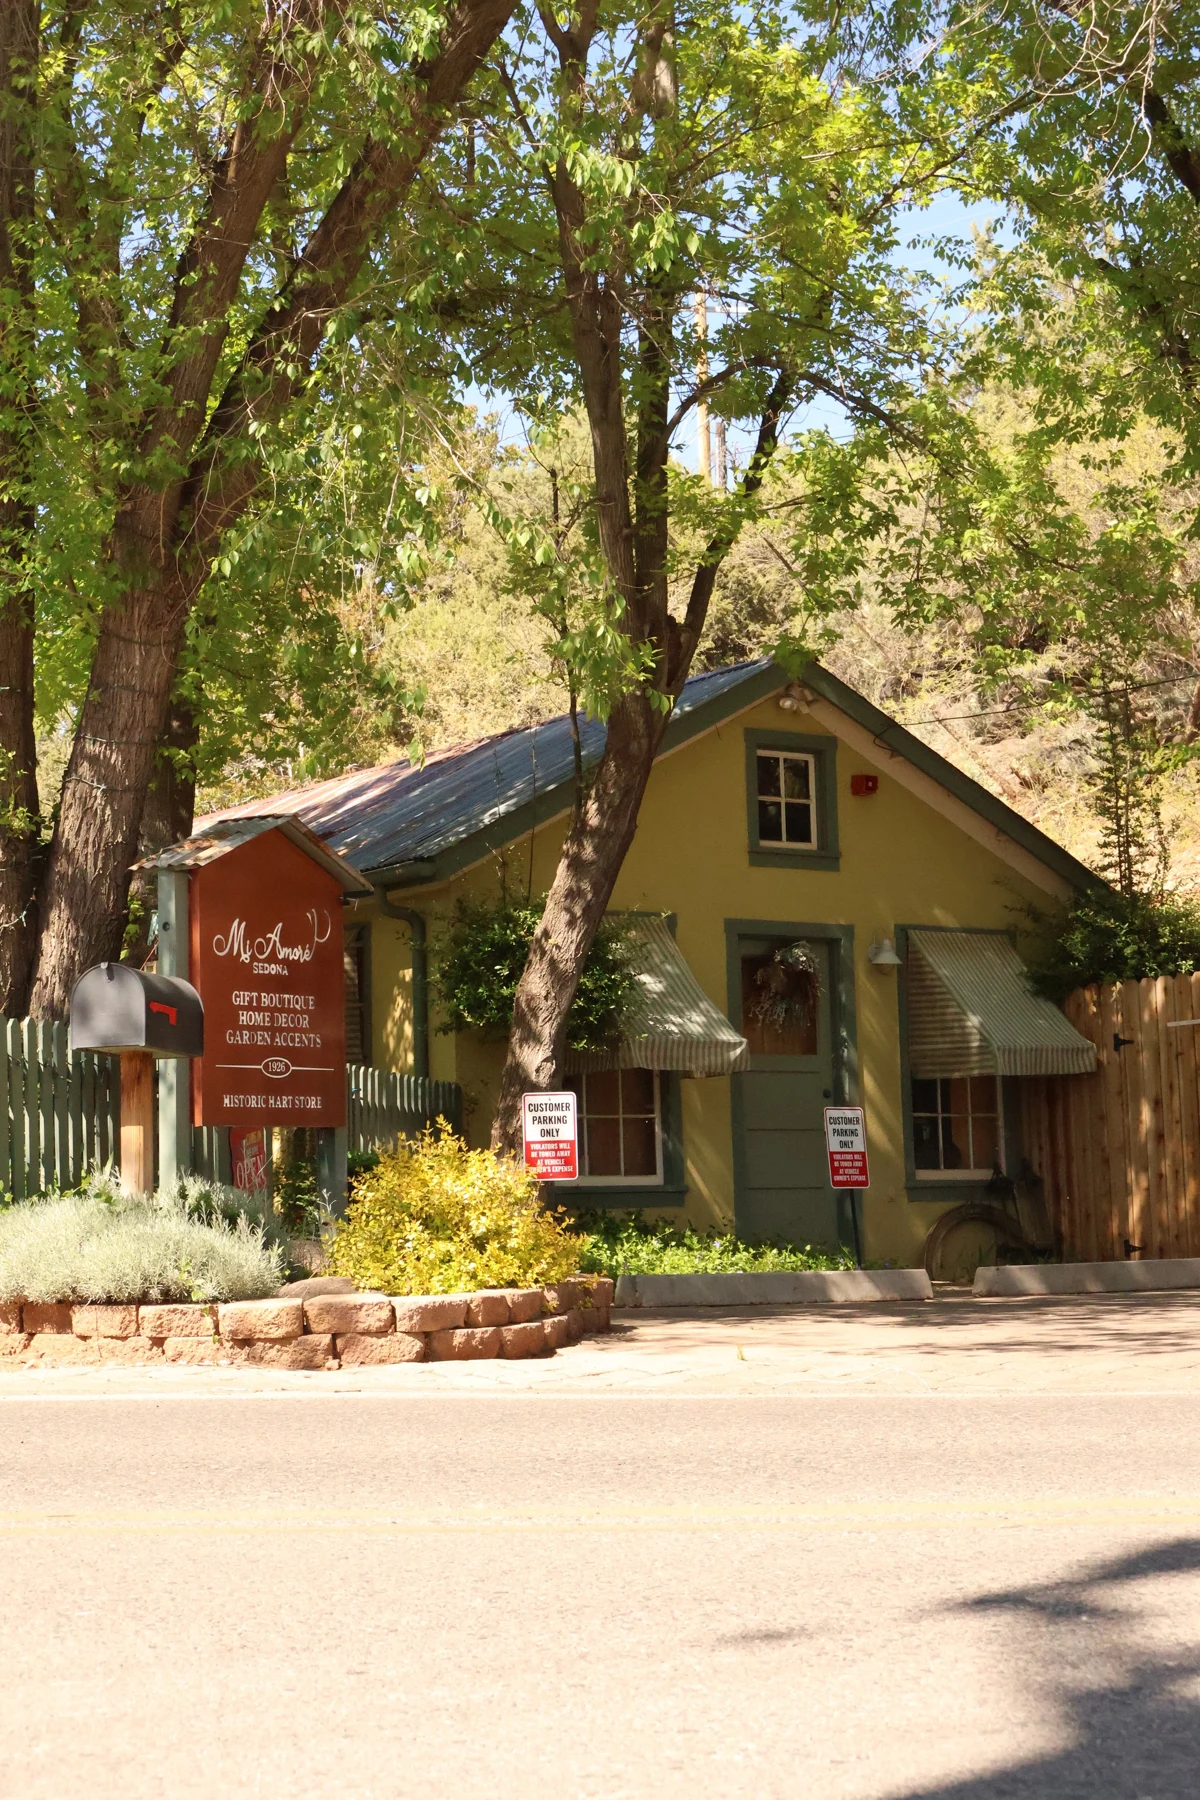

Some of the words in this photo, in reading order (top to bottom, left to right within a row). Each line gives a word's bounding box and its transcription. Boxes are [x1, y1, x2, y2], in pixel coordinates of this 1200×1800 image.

[213, 918, 252, 963] Mi
[253, 962, 288, 976] SEDONA
[232, 991, 258, 1006] GIFT
[261, 992, 315, 1010] BOUTIQUE
[239, 1011, 271, 1026] HOME
[274, 1012, 309, 1028] DECOR
[226, 1030, 271, 1045] GARDEN
[274, 1032, 322, 1047] ACCENTS
[268, 1061, 286, 1072] 1926
[223, 1095, 266, 1108] HISTORIC
[268, 1096, 292, 1108] HART
[295, 1096, 322, 1109] STORE
[528, 1103, 571, 1112] CUSTOMER
[532, 1115, 567, 1125] PARKING
[829, 1116, 860, 1125] CUSTOMER
[540, 1128, 560, 1137] ONLY
[833, 1129, 859, 1137] PARKING
[839, 1140, 854, 1148] ONLY
[539, 1150, 556, 1158] TOWED
